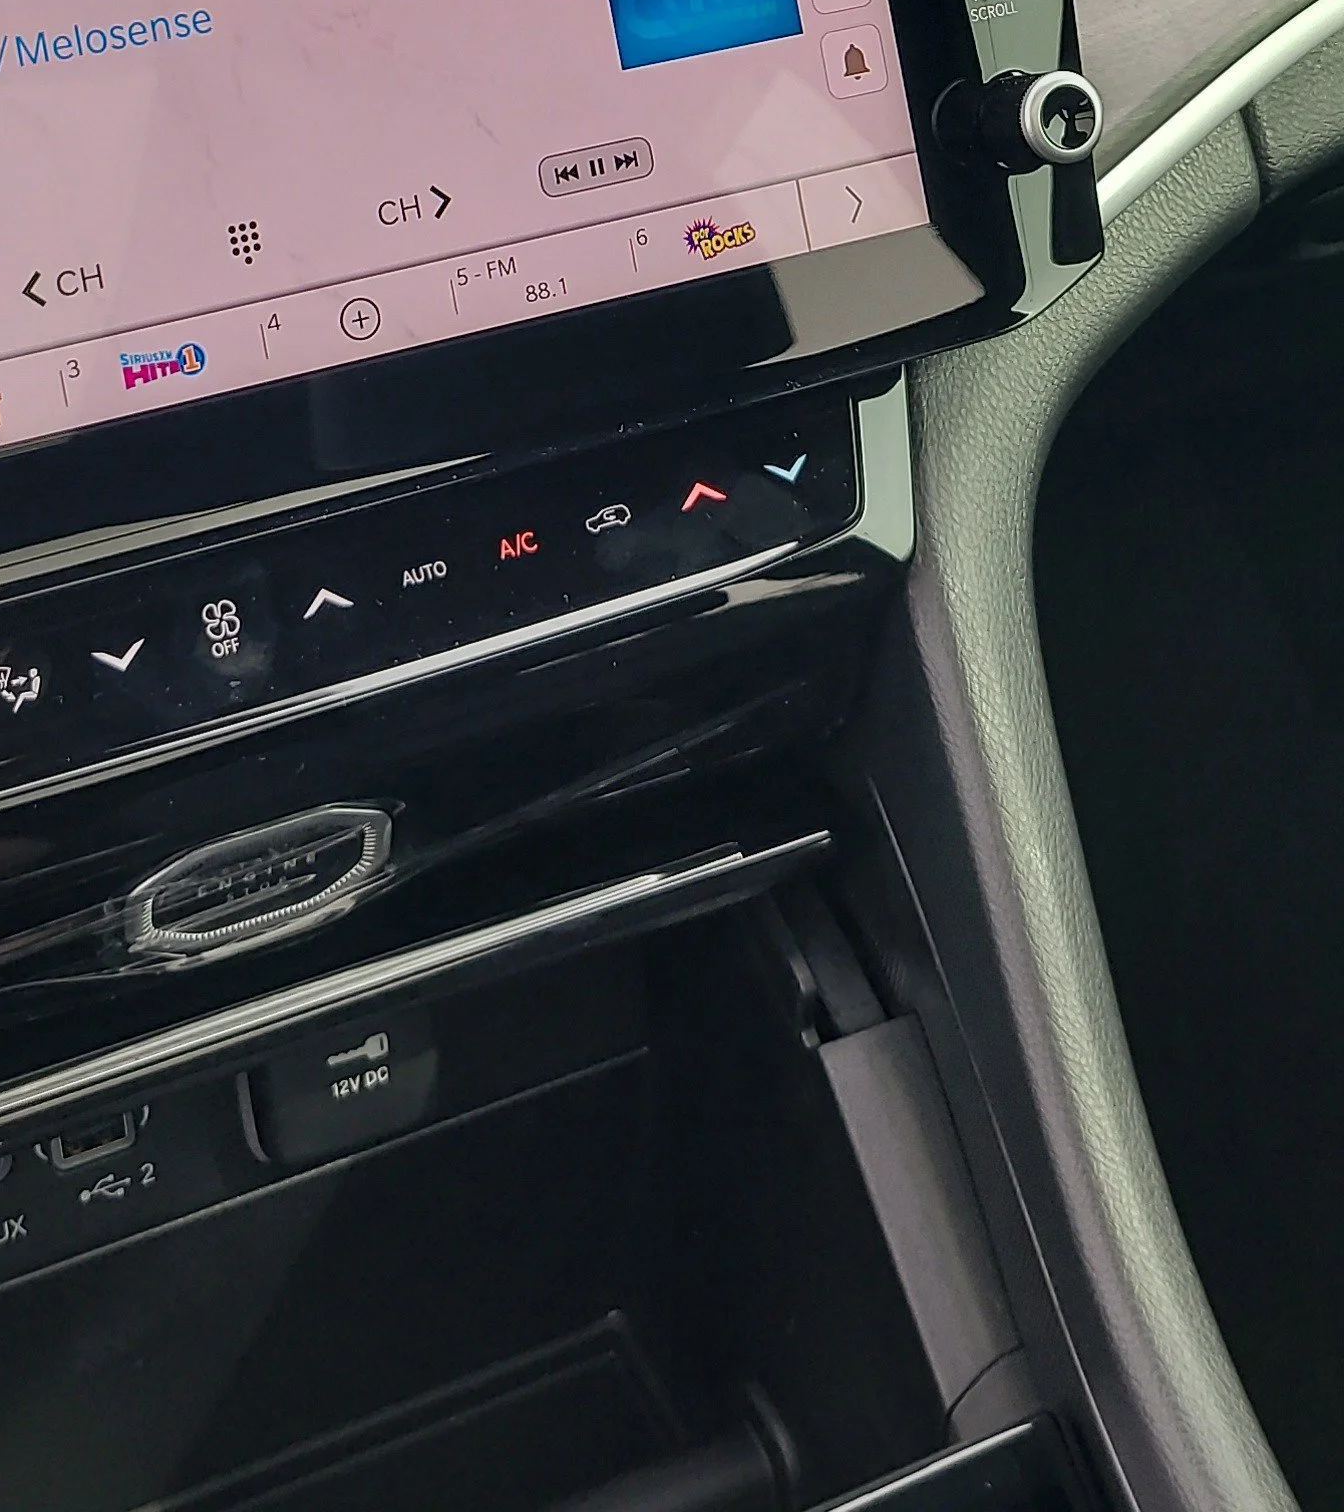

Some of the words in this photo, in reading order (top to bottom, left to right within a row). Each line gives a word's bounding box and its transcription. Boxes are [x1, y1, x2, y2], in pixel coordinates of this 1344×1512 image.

[970, 1, 1018, 23] SCROLL
[378, 192, 423, 229] CH
[635, 228, 649, 247] 6
[691, 227, 711, 248] POP
[700, 221, 756, 261] ROCKS
[55, 263, 105, 298] CH
[457, 267, 469, 287] 5
[485, 256, 518, 281] FM
[525, 277, 568, 303] 88.1
[267, 313, 282, 333] 4
[65, 360, 81, 380] 3
[498, 530, 538, 561] A/C
[402, 560, 448, 589] AUTO
[211, 638, 240, 660] OFF
[330, 1073, 363, 1099] 12V
[365, 1065, 391, 1090] DC
[140, 1161, 157, 1187] 2
